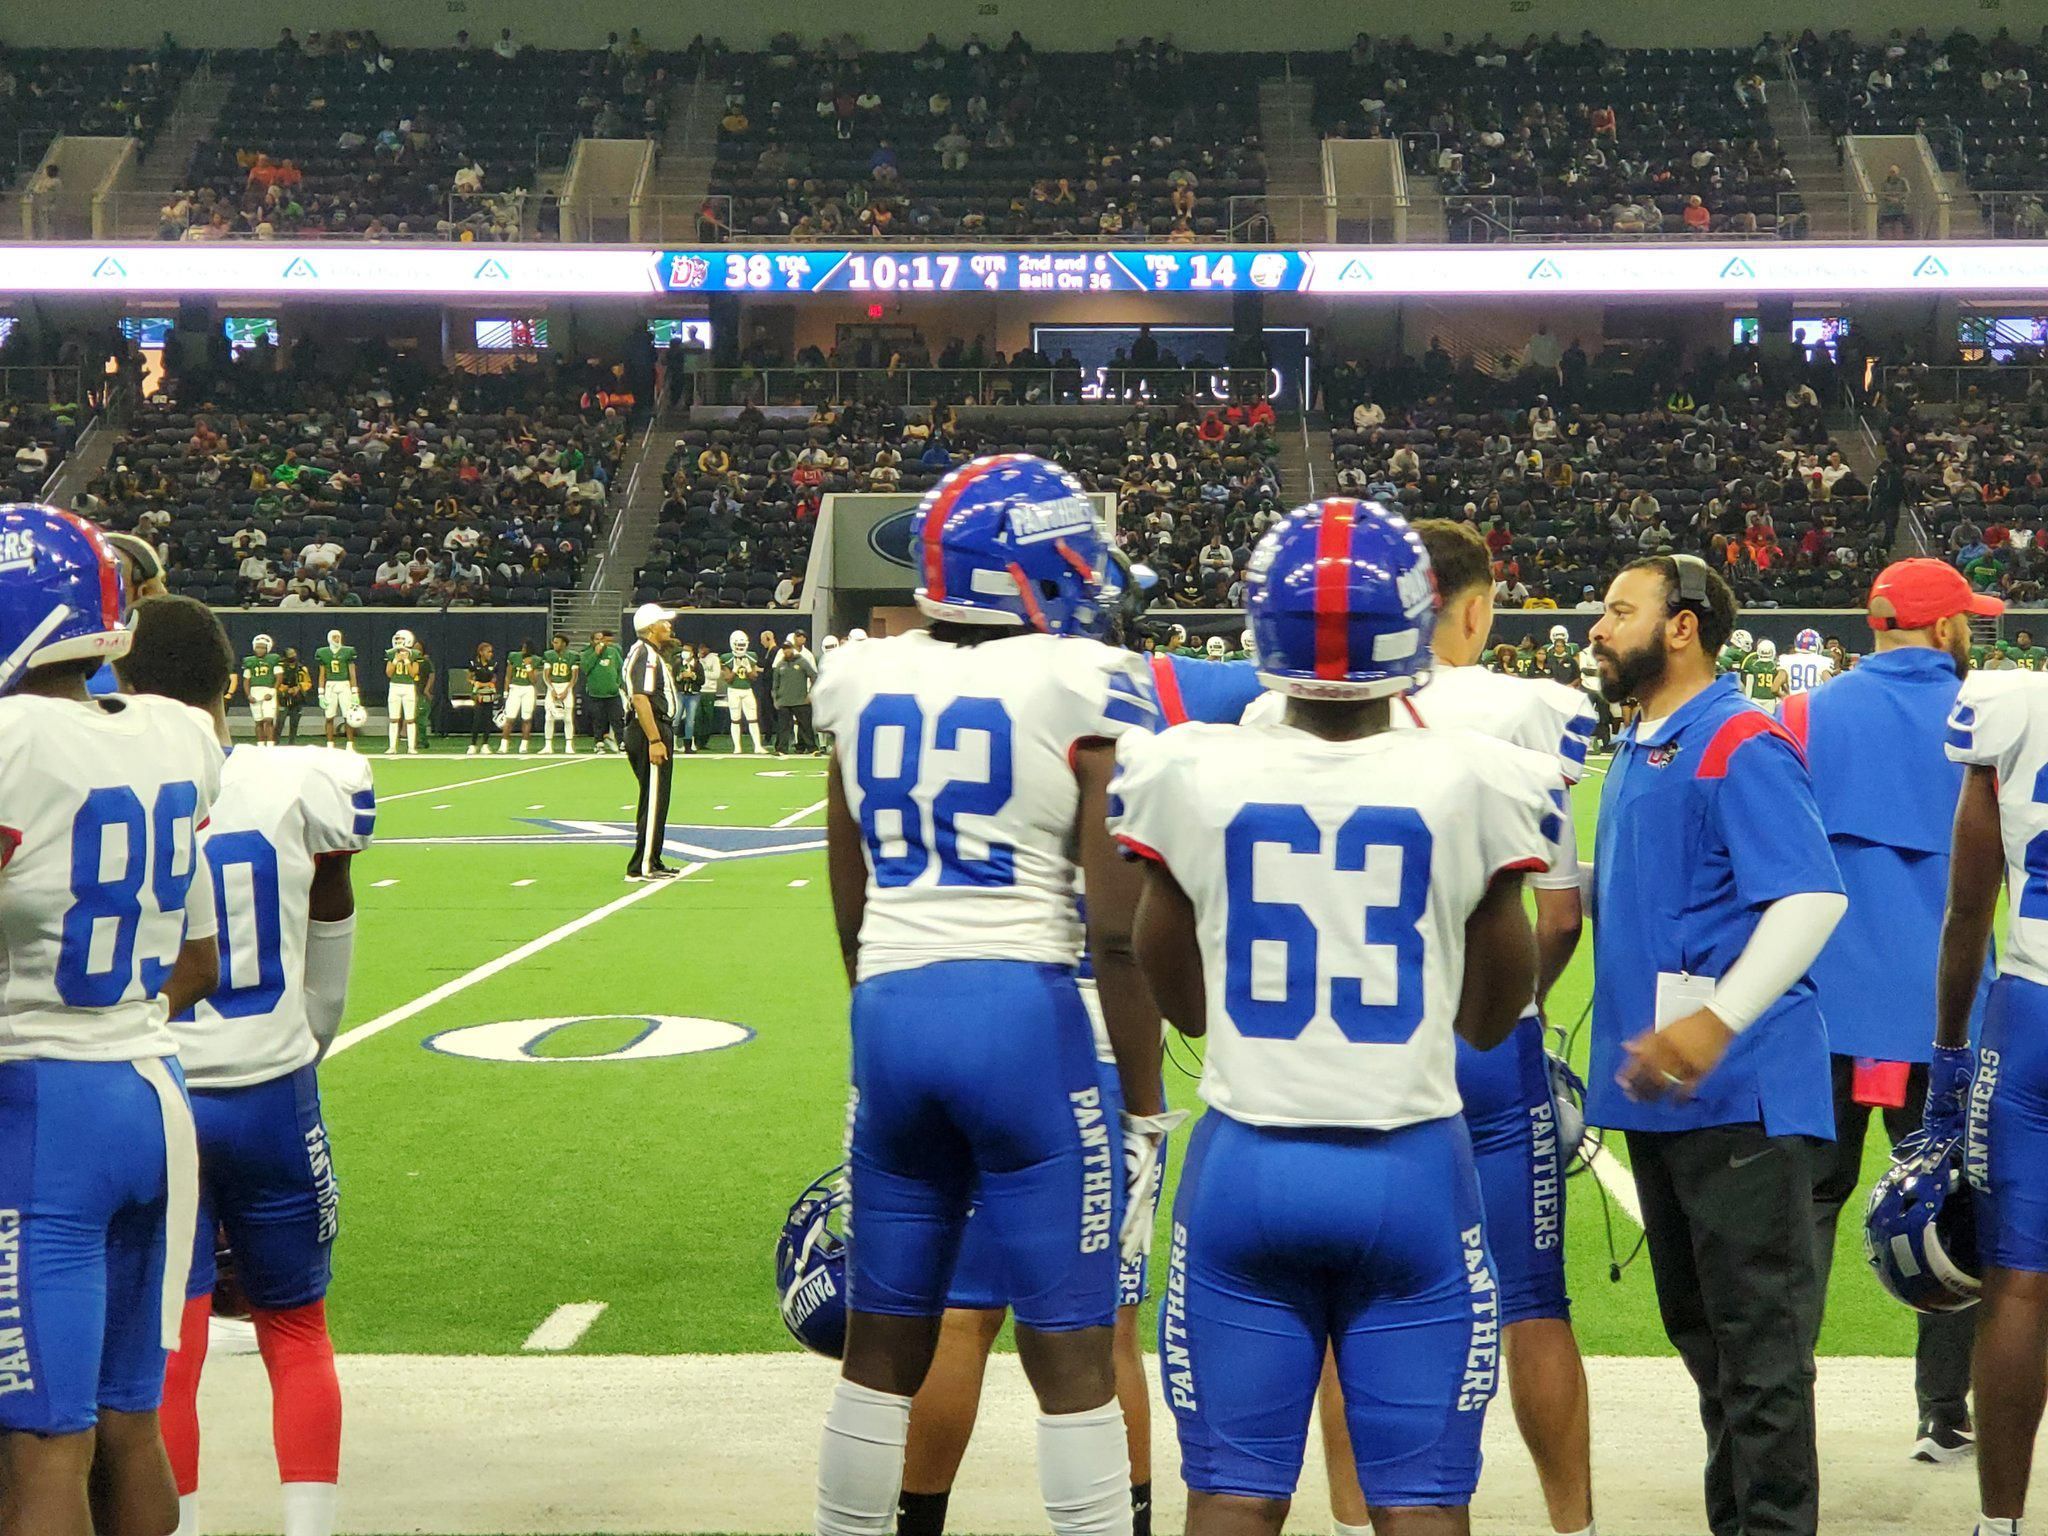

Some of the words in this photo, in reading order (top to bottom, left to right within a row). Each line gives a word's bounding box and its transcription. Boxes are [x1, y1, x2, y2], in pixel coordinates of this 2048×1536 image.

[725, 254, 773, 288] 38
[775, 255, 811, 272] TOL
[849, 256, 959, 288] 10:17
[970, 255, 1007, 273] QTR
[1018, 254, 1051, 271] 2nd
[1054, 254, 1087, 271] and
[1094, 255, 1106, 271] 6
[1144, 255, 1179, 271] TOL
[1190, 254, 1237, 287] 14
[786, 271, 800, 288] 2
[983, 272, 998, 289] 4
[1019, 272, 1054, 288] Ball
[1058, 272, 1083, 288] On
[1089, 273, 1111, 289] 36
[1155, 270, 1168, 288] 3
[1757, 674, 1773, 688] 39
[1791, 664, 1817, 691] 80
[857, 693, 1015, 888] 82
[54, 780, 198, 1007] 89
[168, 830, 286, 1022] 0
[1224, 802, 1433, 1045] 63
[1969, 1047, 2000, 1194] PANTHERS
[1069, 1086, 1111, 1255] PANTHERS
[1531, 1101, 1560, 1252] PANTHERS
[1162, 1220, 1197, 1412] PANTHERS
[1458, 1224, 1501, 1412] PANTHERS
